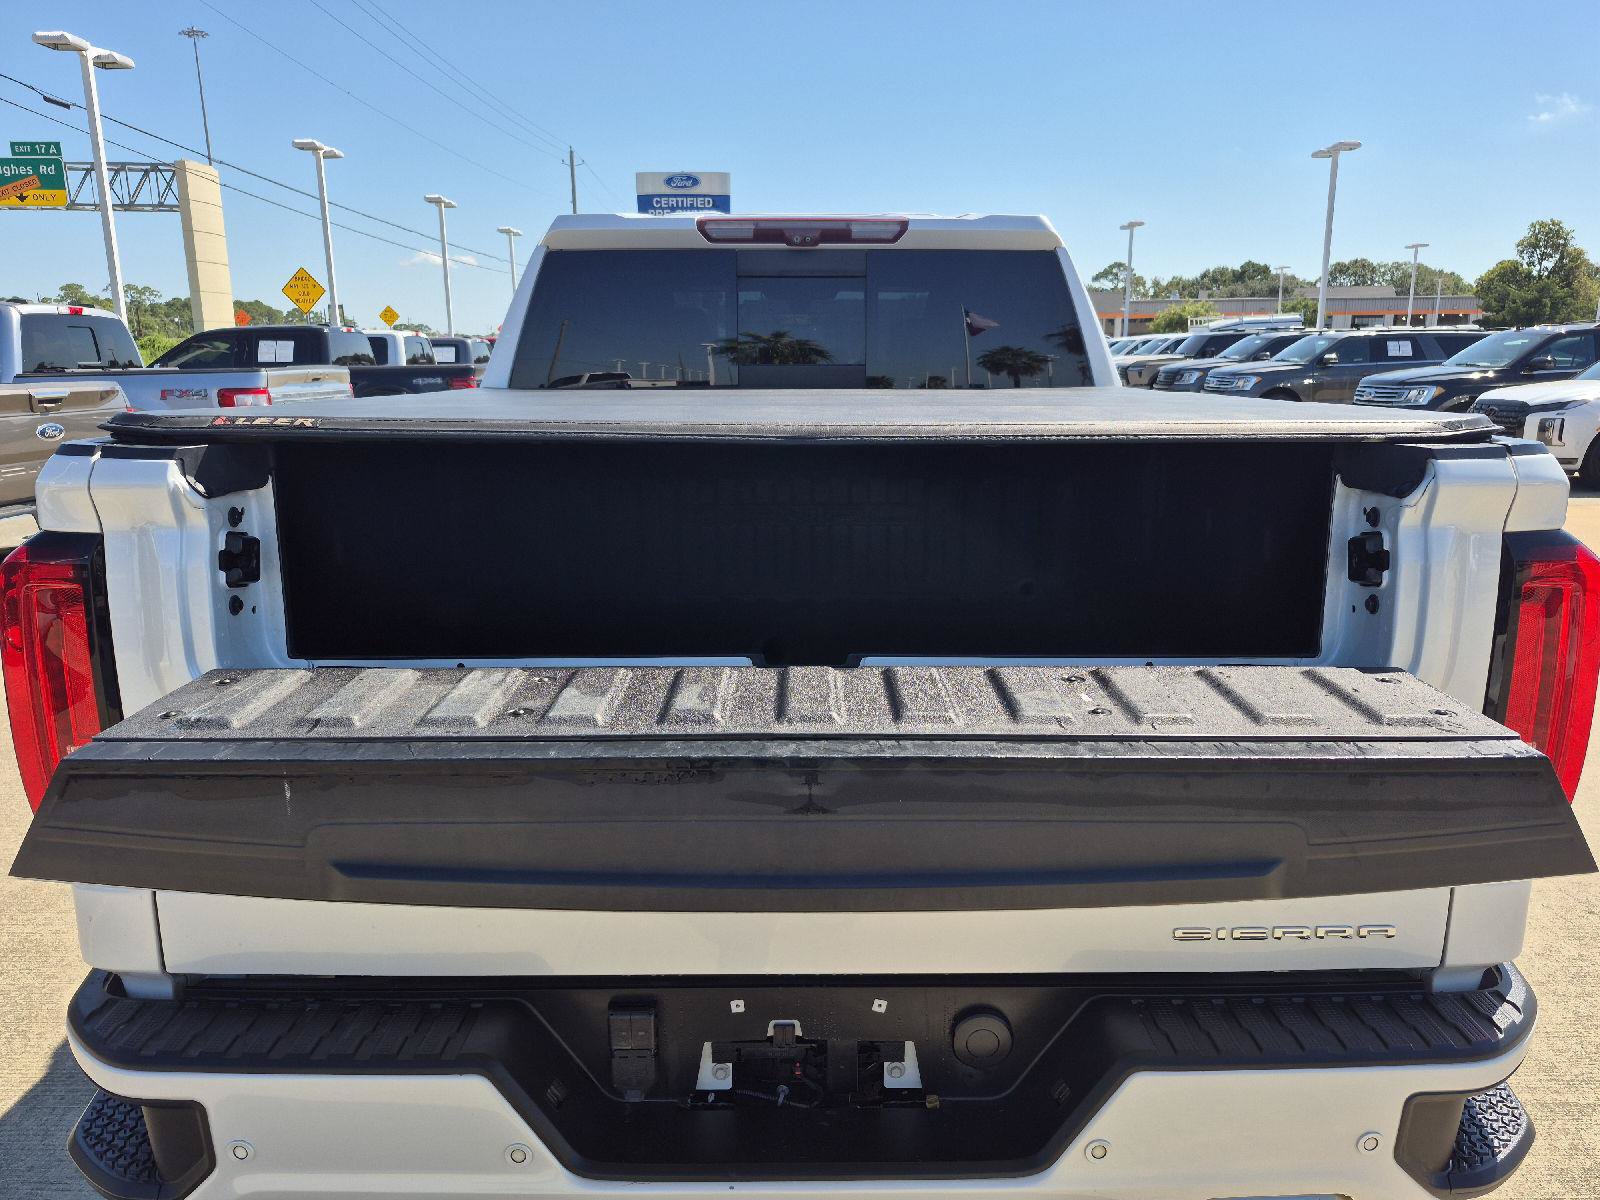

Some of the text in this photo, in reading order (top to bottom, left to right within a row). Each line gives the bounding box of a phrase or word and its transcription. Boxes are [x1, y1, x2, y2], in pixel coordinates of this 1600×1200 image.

[35, 144, 46, 153] 17
[50, 144, 57, 153] A
[40, 164, 55, 174] Rd
[671, 176, 693, 187] Ford
[32, 193, 57, 201] ONLY
[652, 197, 713, 208] CERTIFIED
[160, 388, 208, 400] FX4
[233, 417, 316, 427] LEER
[1172, 924, 1398, 941] SIERRA
